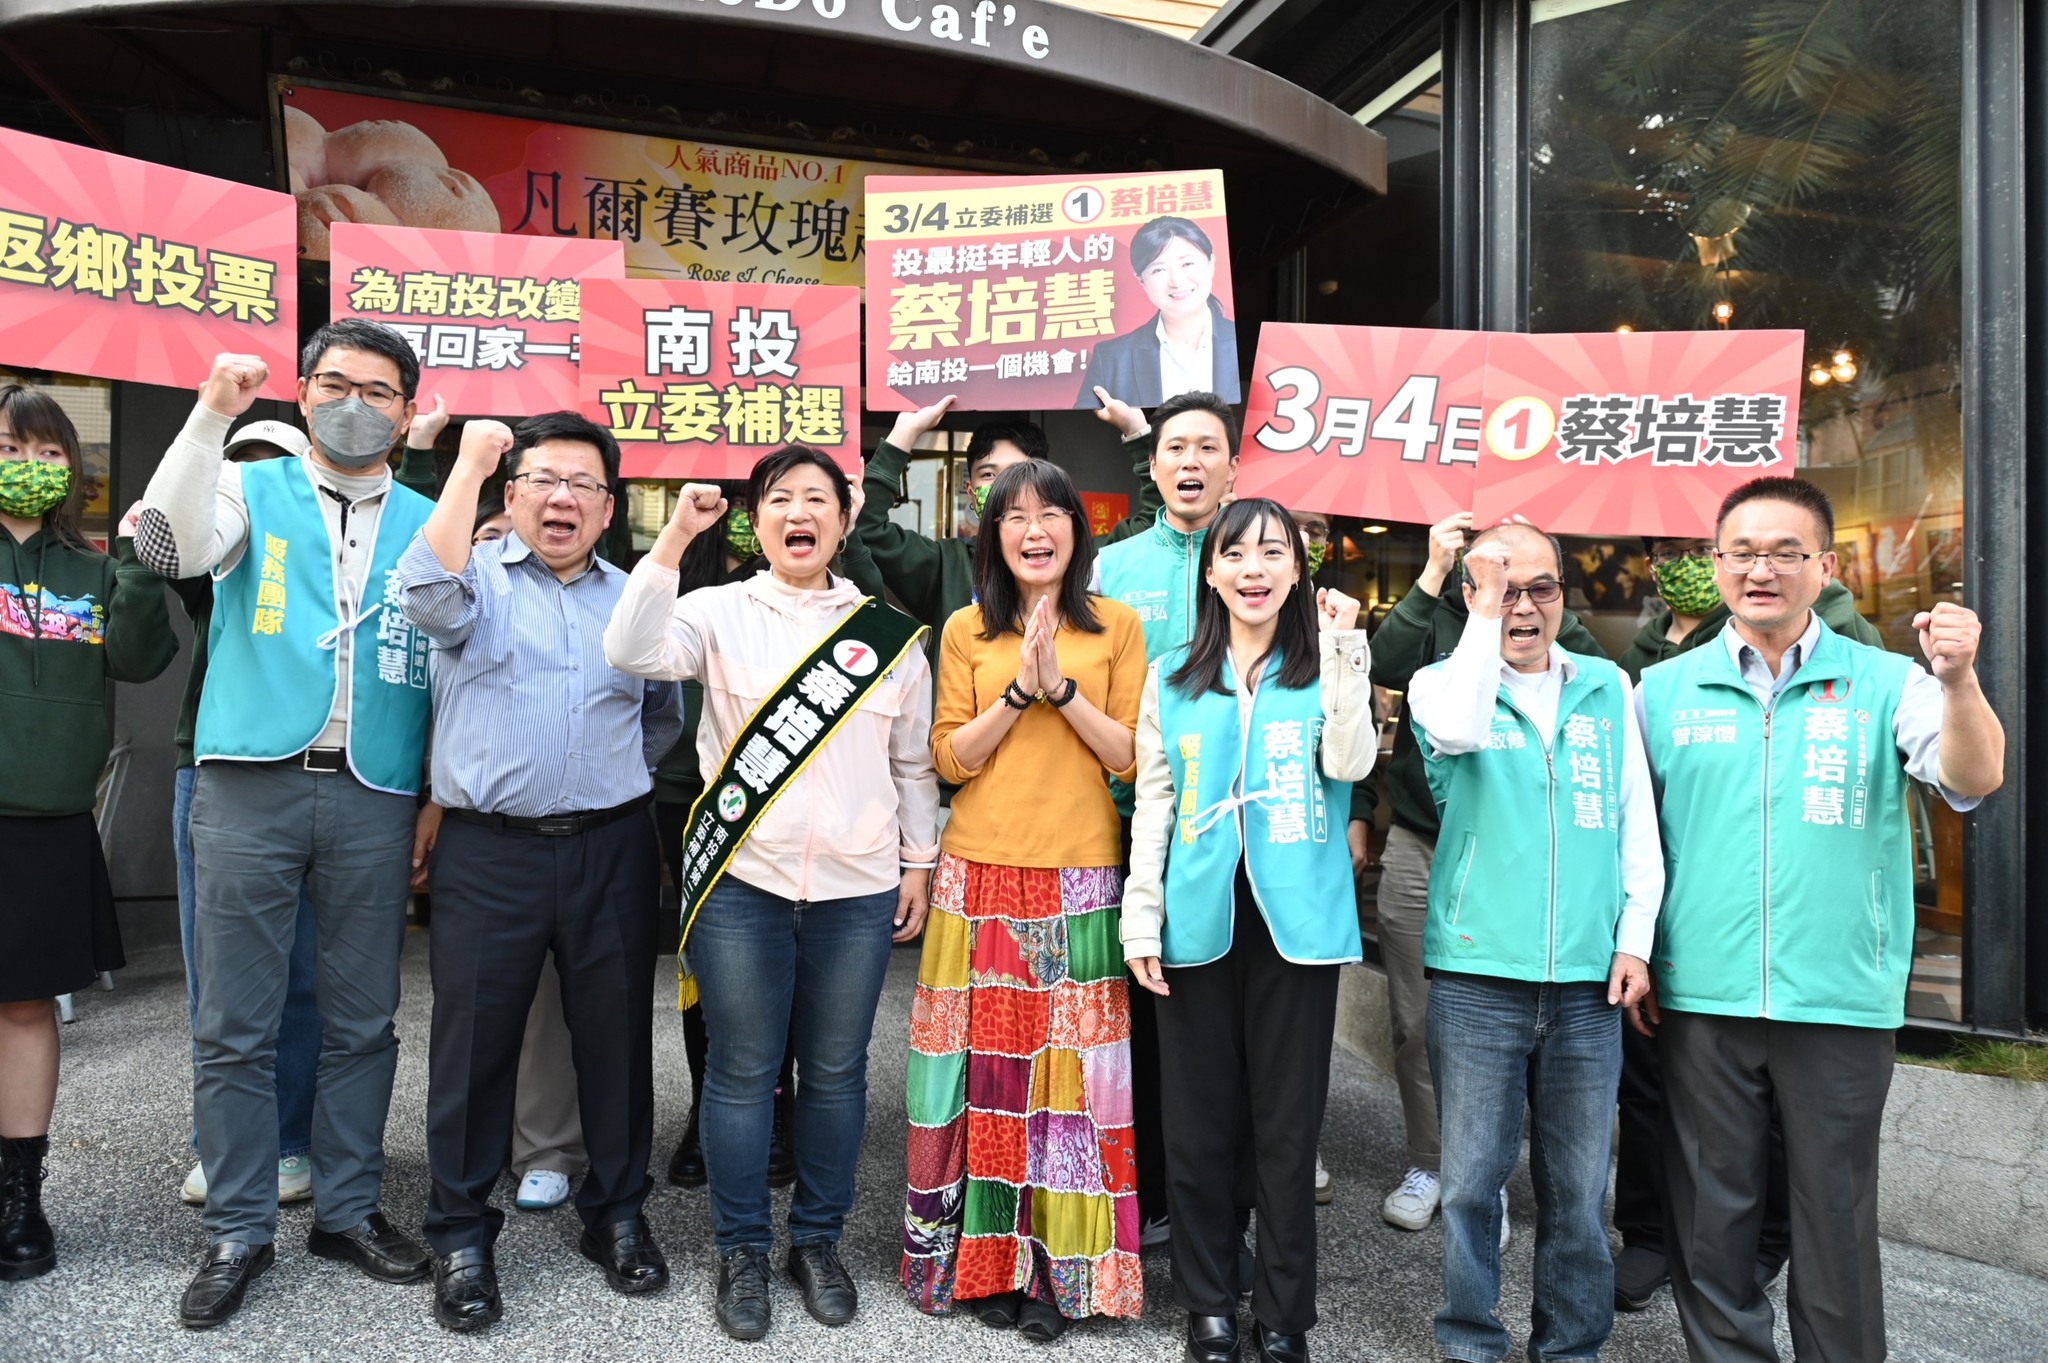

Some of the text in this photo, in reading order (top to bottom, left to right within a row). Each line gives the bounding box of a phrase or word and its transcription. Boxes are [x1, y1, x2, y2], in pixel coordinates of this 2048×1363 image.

[665, 144, 844, 184] 人氣商品NO.1
[512, 169, 865, 263] 凡爾賽玫瑰
[883, 201, 950, 234] 3/4
[953, 202, 1054, 229] 立委補選
[1110, 180, 1214, 218] 蔡培慧
[0, 207, 279, 326] 返鄉投票
[687, 262, 731, 281] Rose
[891, 233, 1115, 278] 投最挺年輕人的
[348, 266, 579, 323] 為南投改變
[886, 268, 1116, 351] 蔡培慧
[379, 321, 579, 372] 再回家一
[886, 348, 1088, 387] 給南投一個機會!
[599, 377, 848, 447] 立委補選
[1254, 365, 1482, 468] 3月4日
[1556, 393, 1787, 468] 蔡培慧
[733, 659, 857, 795] 蔡培慧
[1262, 720, 1309, 844] 蔡培慧
[1563, 713, 1605, 829] 蔡培慧
[1801, 706, 1849, 825] 蔡培慧
